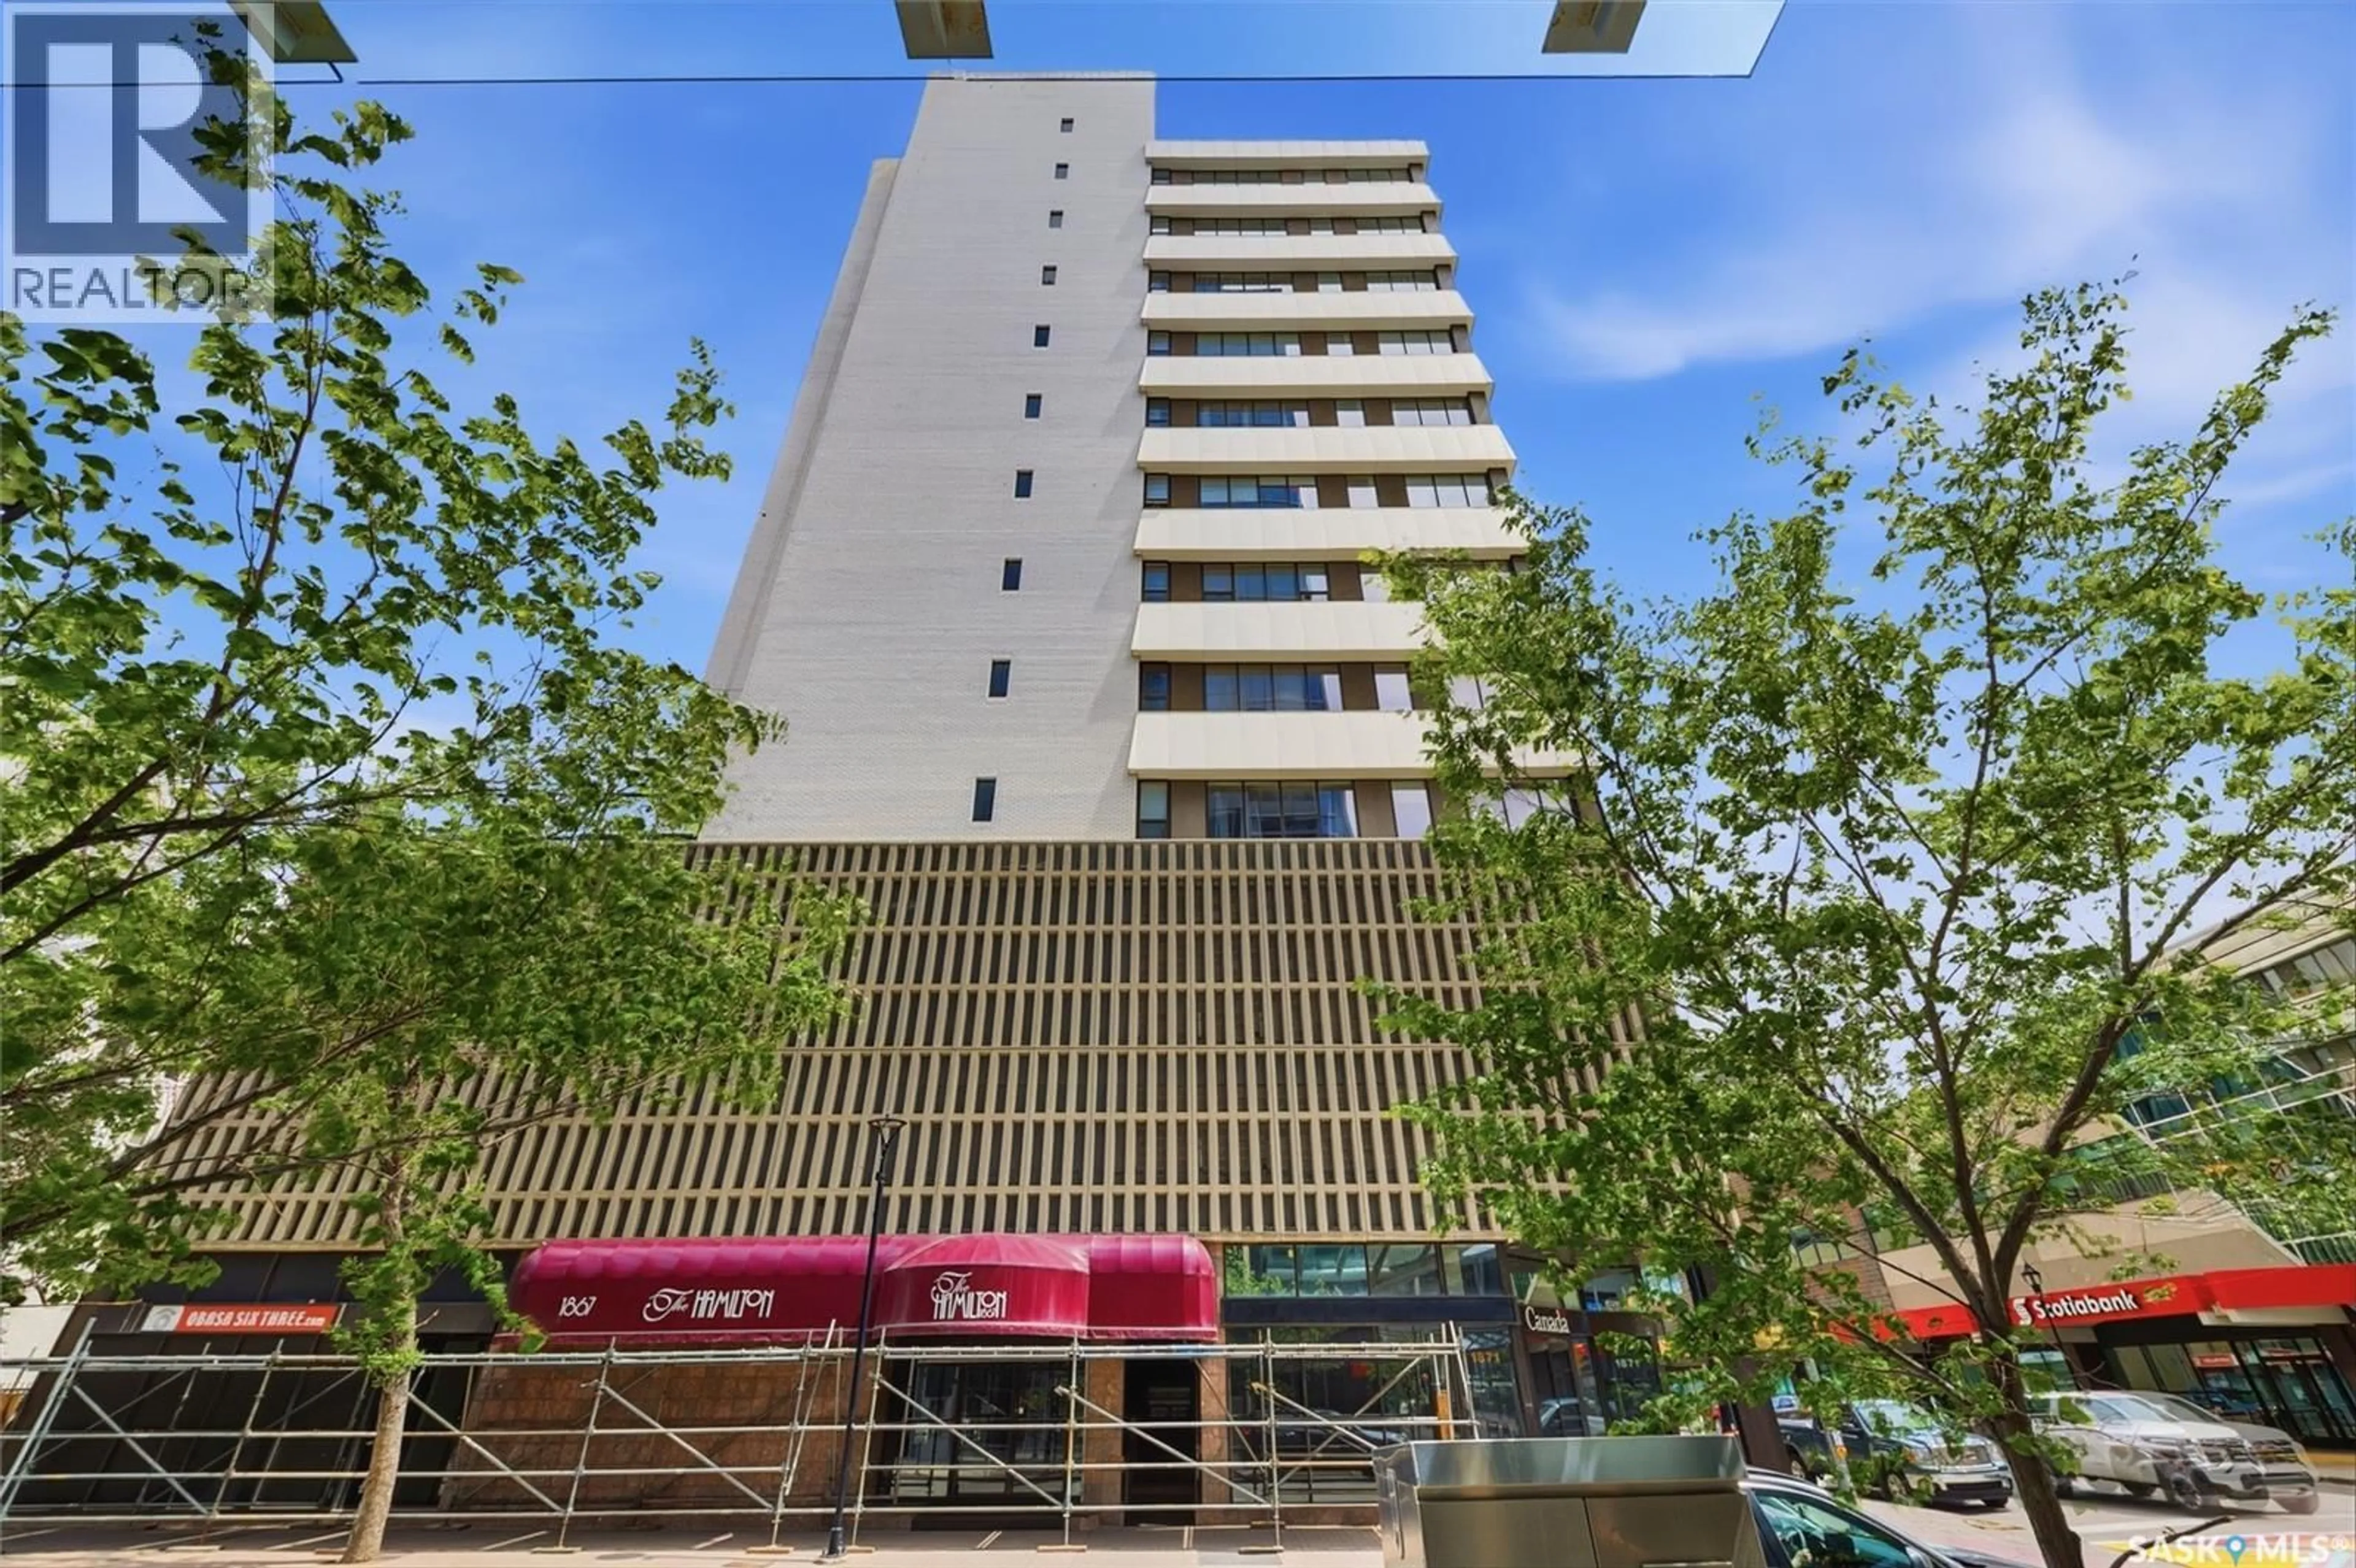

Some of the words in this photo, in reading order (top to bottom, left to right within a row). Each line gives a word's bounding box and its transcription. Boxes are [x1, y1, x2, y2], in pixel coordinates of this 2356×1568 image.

[931, 1272, 972, 1302] The
[233, 1311, 260, 1327] SIX
[559, 1296, 597, 1317] 1867
[642, 1288, 694, 1322] The
[691, 1289, 775, 1318] HAMILTON
[933, 1291, 1007, 1320] HAMILTON
[1525, 1306, 1570, 1333] Canada
